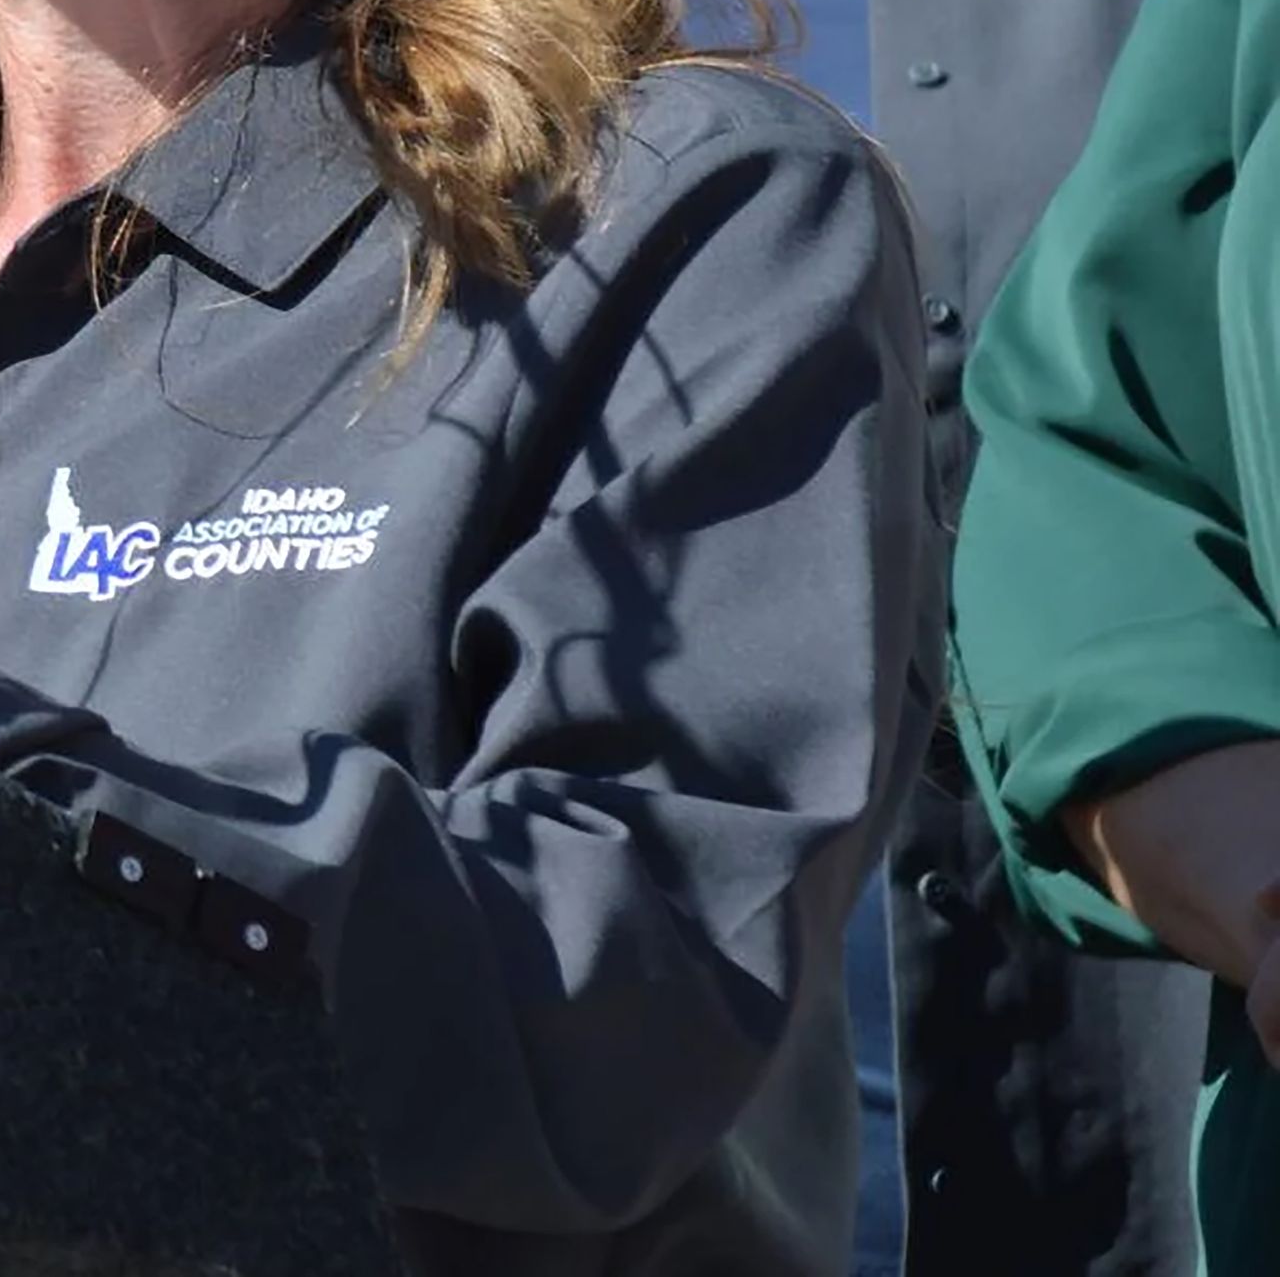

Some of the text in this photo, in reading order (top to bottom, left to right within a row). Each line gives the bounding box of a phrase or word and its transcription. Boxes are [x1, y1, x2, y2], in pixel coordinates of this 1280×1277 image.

[242, 487, 346, 514] IDAHO
[172, 504, 390, 544] ASSOCIATION OF
[44, 524, 159, 597] IAC
[163, 529, 379, 580] COUNTIES
